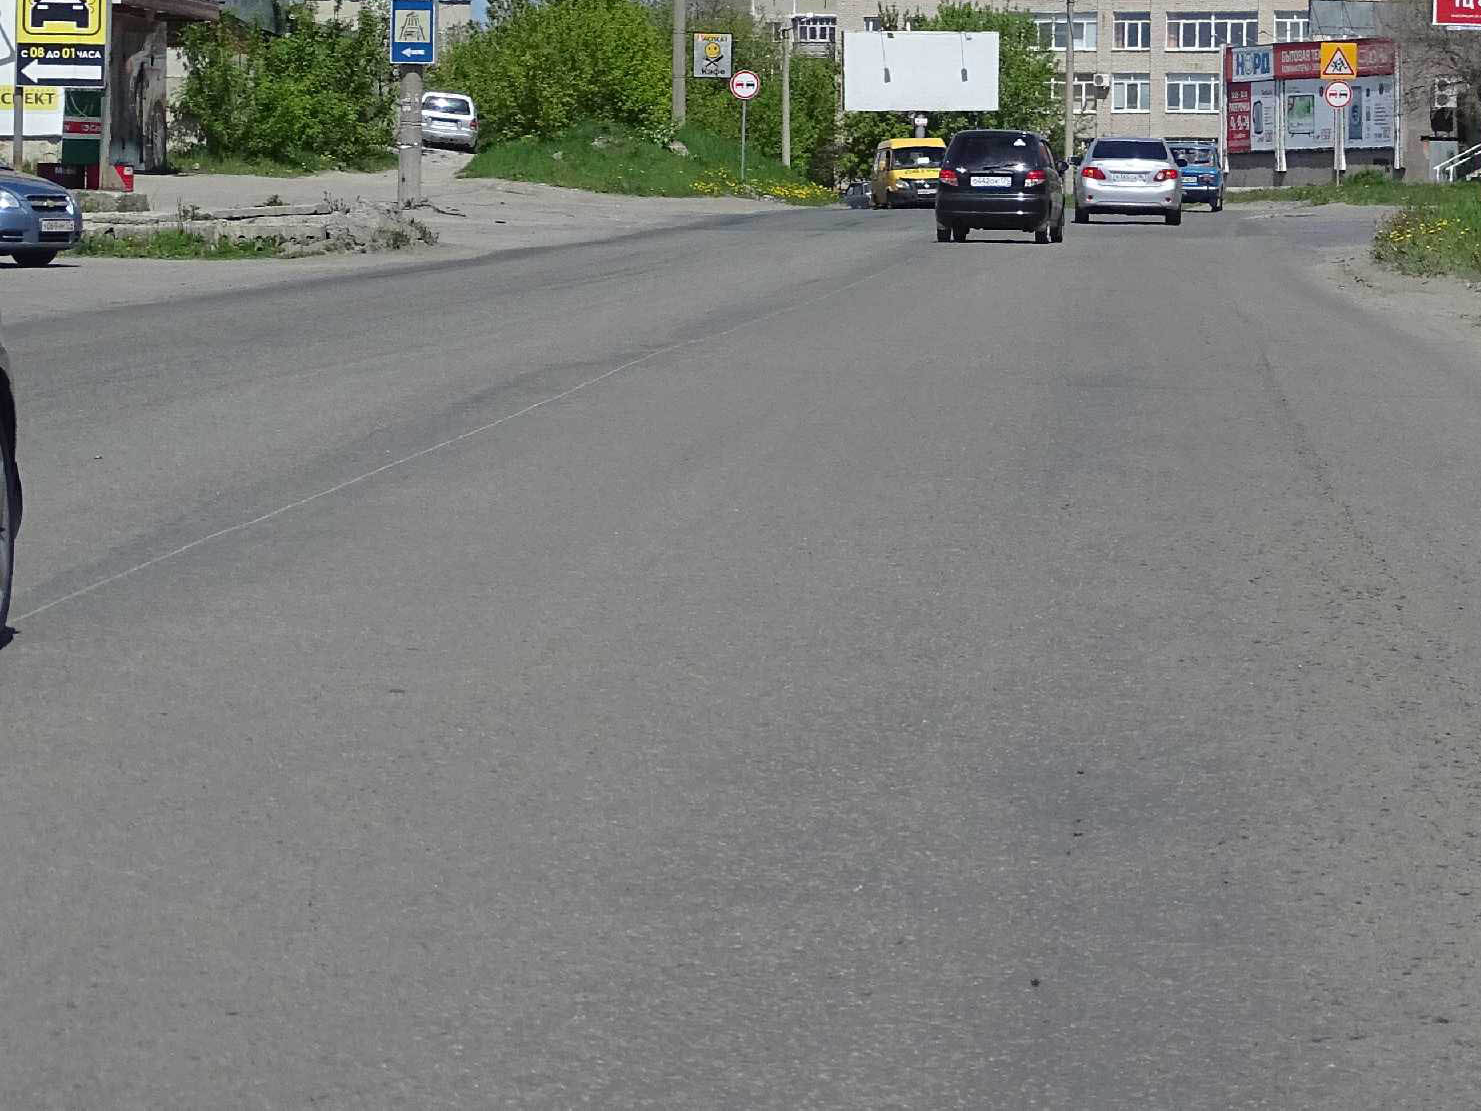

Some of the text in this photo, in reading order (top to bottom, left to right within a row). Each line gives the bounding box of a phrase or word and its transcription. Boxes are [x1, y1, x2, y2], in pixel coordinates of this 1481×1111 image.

[29, 46, 45, 59] 08
[46, 51, 60, 59] ДО
[61, 47, 76, 59] 01
[77, 51, 101, 59] ЧАСА
[0, 92, 55, 105] СЕКТ
